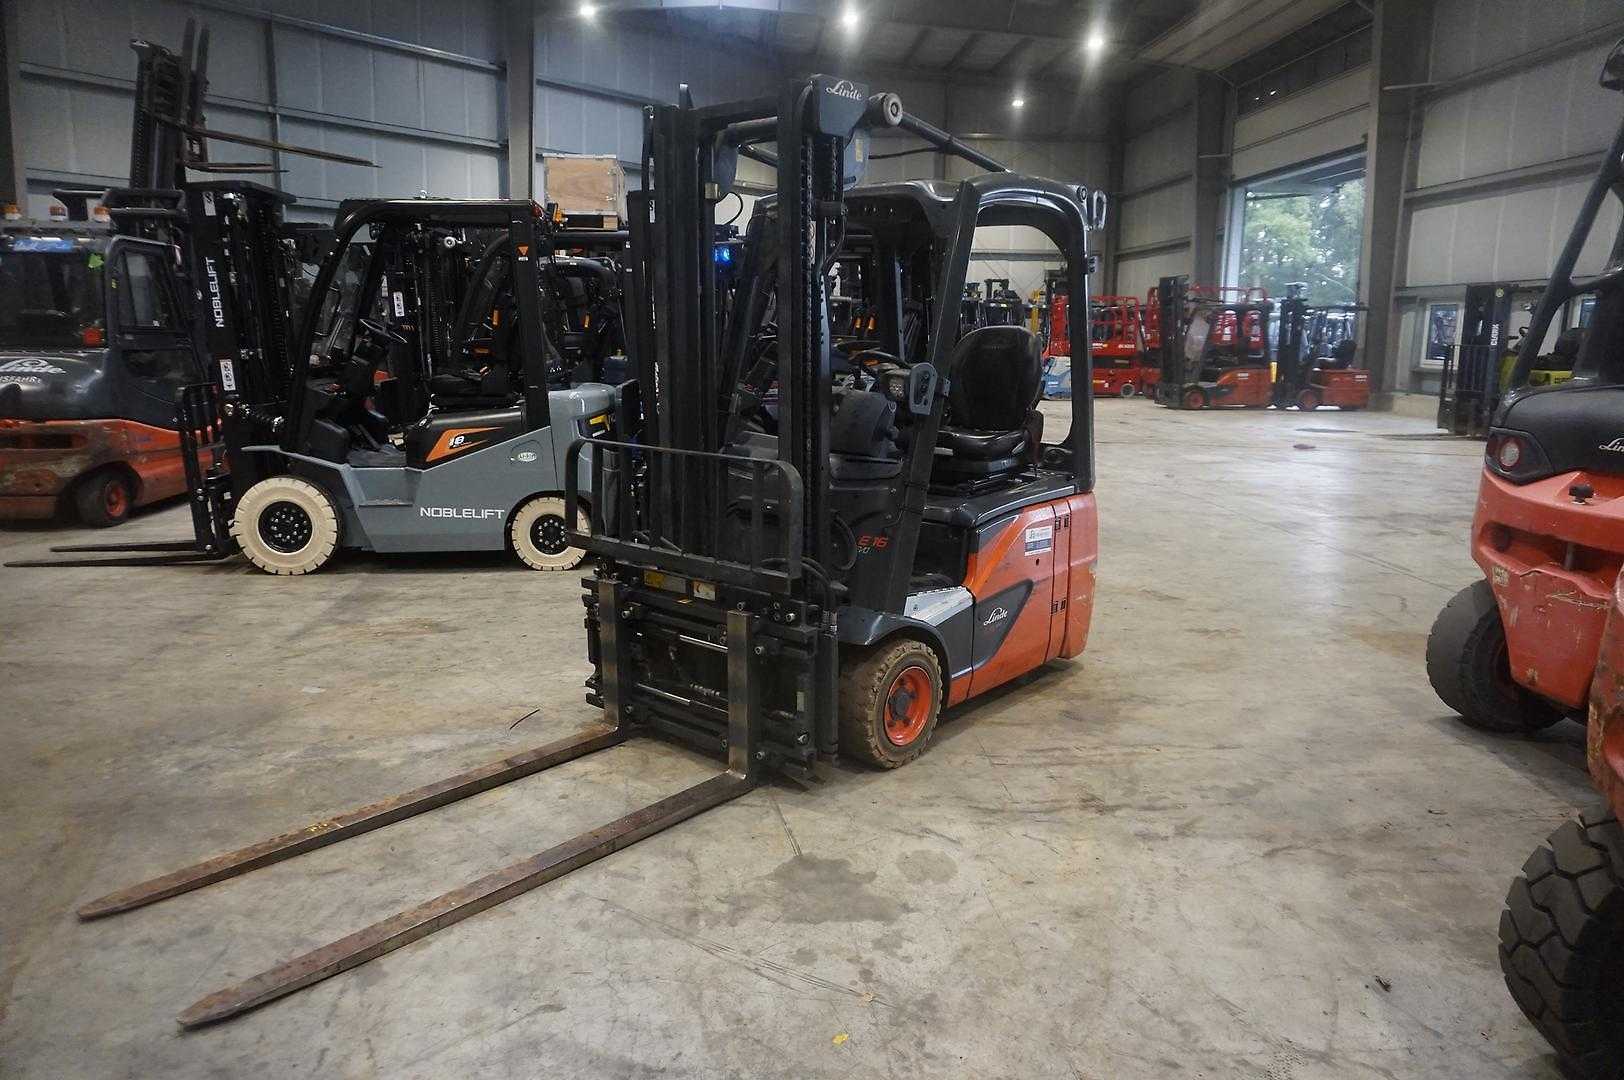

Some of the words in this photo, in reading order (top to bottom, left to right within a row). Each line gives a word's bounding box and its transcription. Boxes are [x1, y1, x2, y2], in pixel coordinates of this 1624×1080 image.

[825, 80, 862, 101] Linde
[205, 257, 225, 328] NOBLELIFT
[420, 507, 505, 519] NOBLELIFT
[983, 607, 1008, 625] Linde
